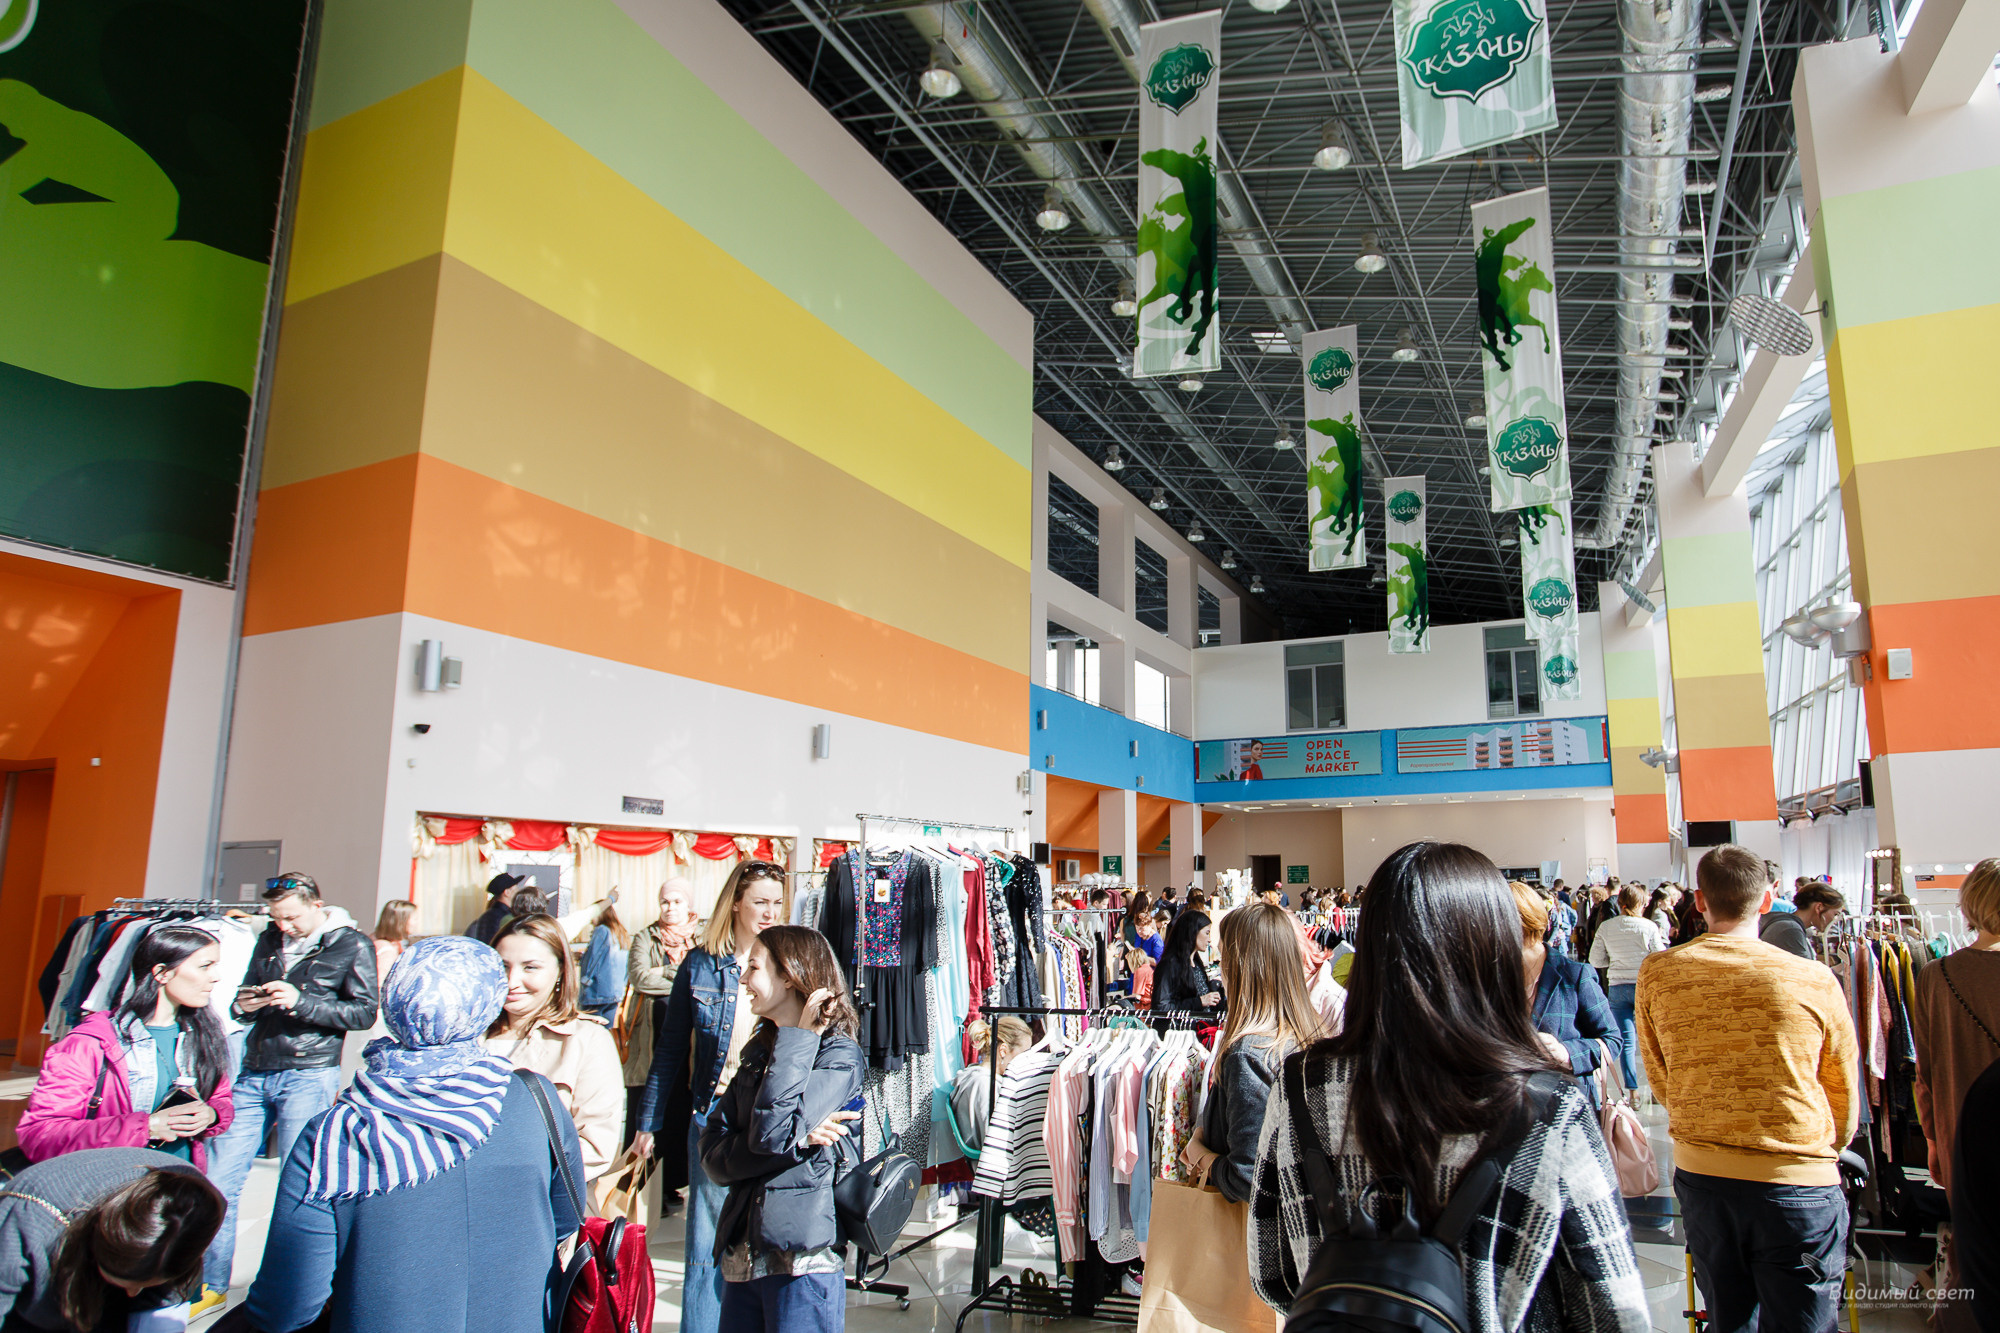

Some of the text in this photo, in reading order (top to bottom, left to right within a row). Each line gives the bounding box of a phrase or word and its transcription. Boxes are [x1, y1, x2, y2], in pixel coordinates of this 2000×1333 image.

[1417, 33, 1523, 76] КАЗАНЬ
[1153, 72, 1205, 94] КАЗАНЬ
[1500, 444, 1555, 463] КАЗАНЬ
[1306, 739, 1343, 750] OPEN
[1306, 750, 1351, 761] SPACE
[1305, 761, 1359, 773] MARKET
